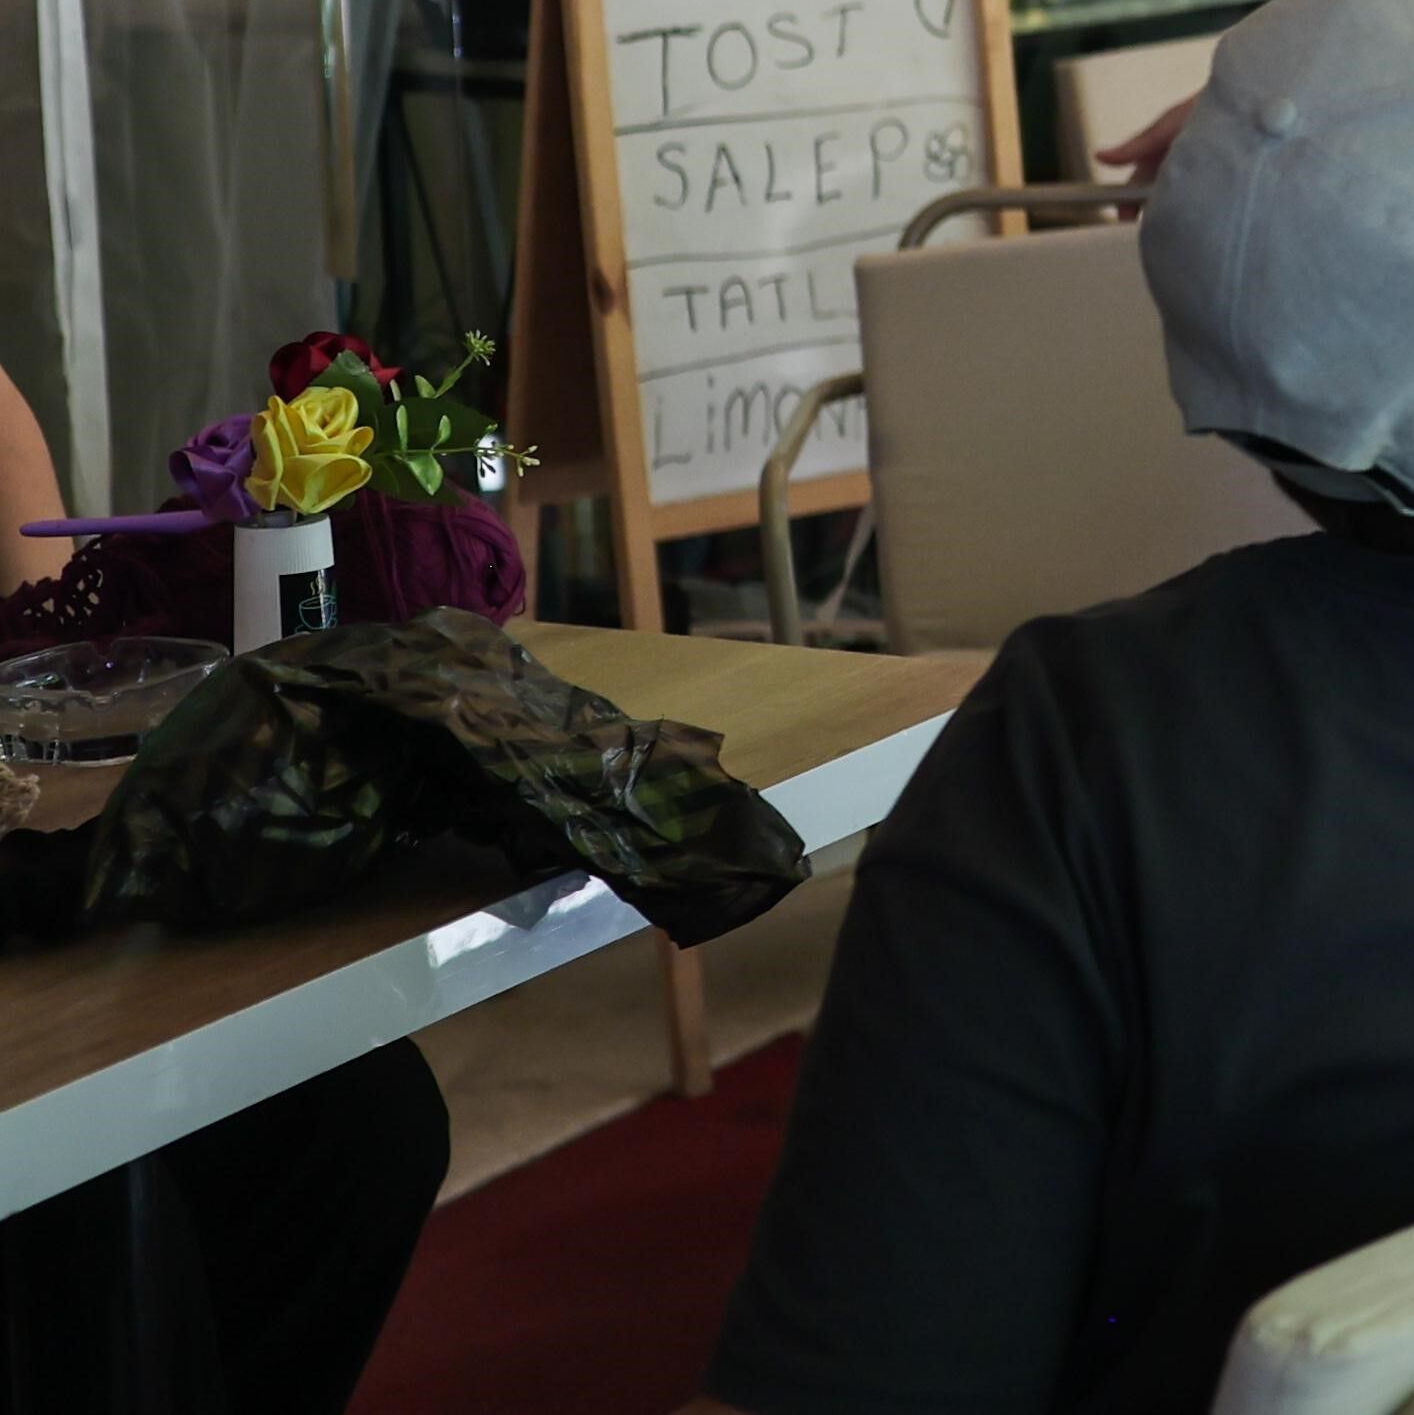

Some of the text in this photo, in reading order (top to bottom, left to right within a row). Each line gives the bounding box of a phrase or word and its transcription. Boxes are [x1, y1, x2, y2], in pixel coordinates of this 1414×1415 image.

[616, 0, 865, 118] TOST
[653, 116, 911, 215] SALEP
[661, 268, 858, 333] TATL
